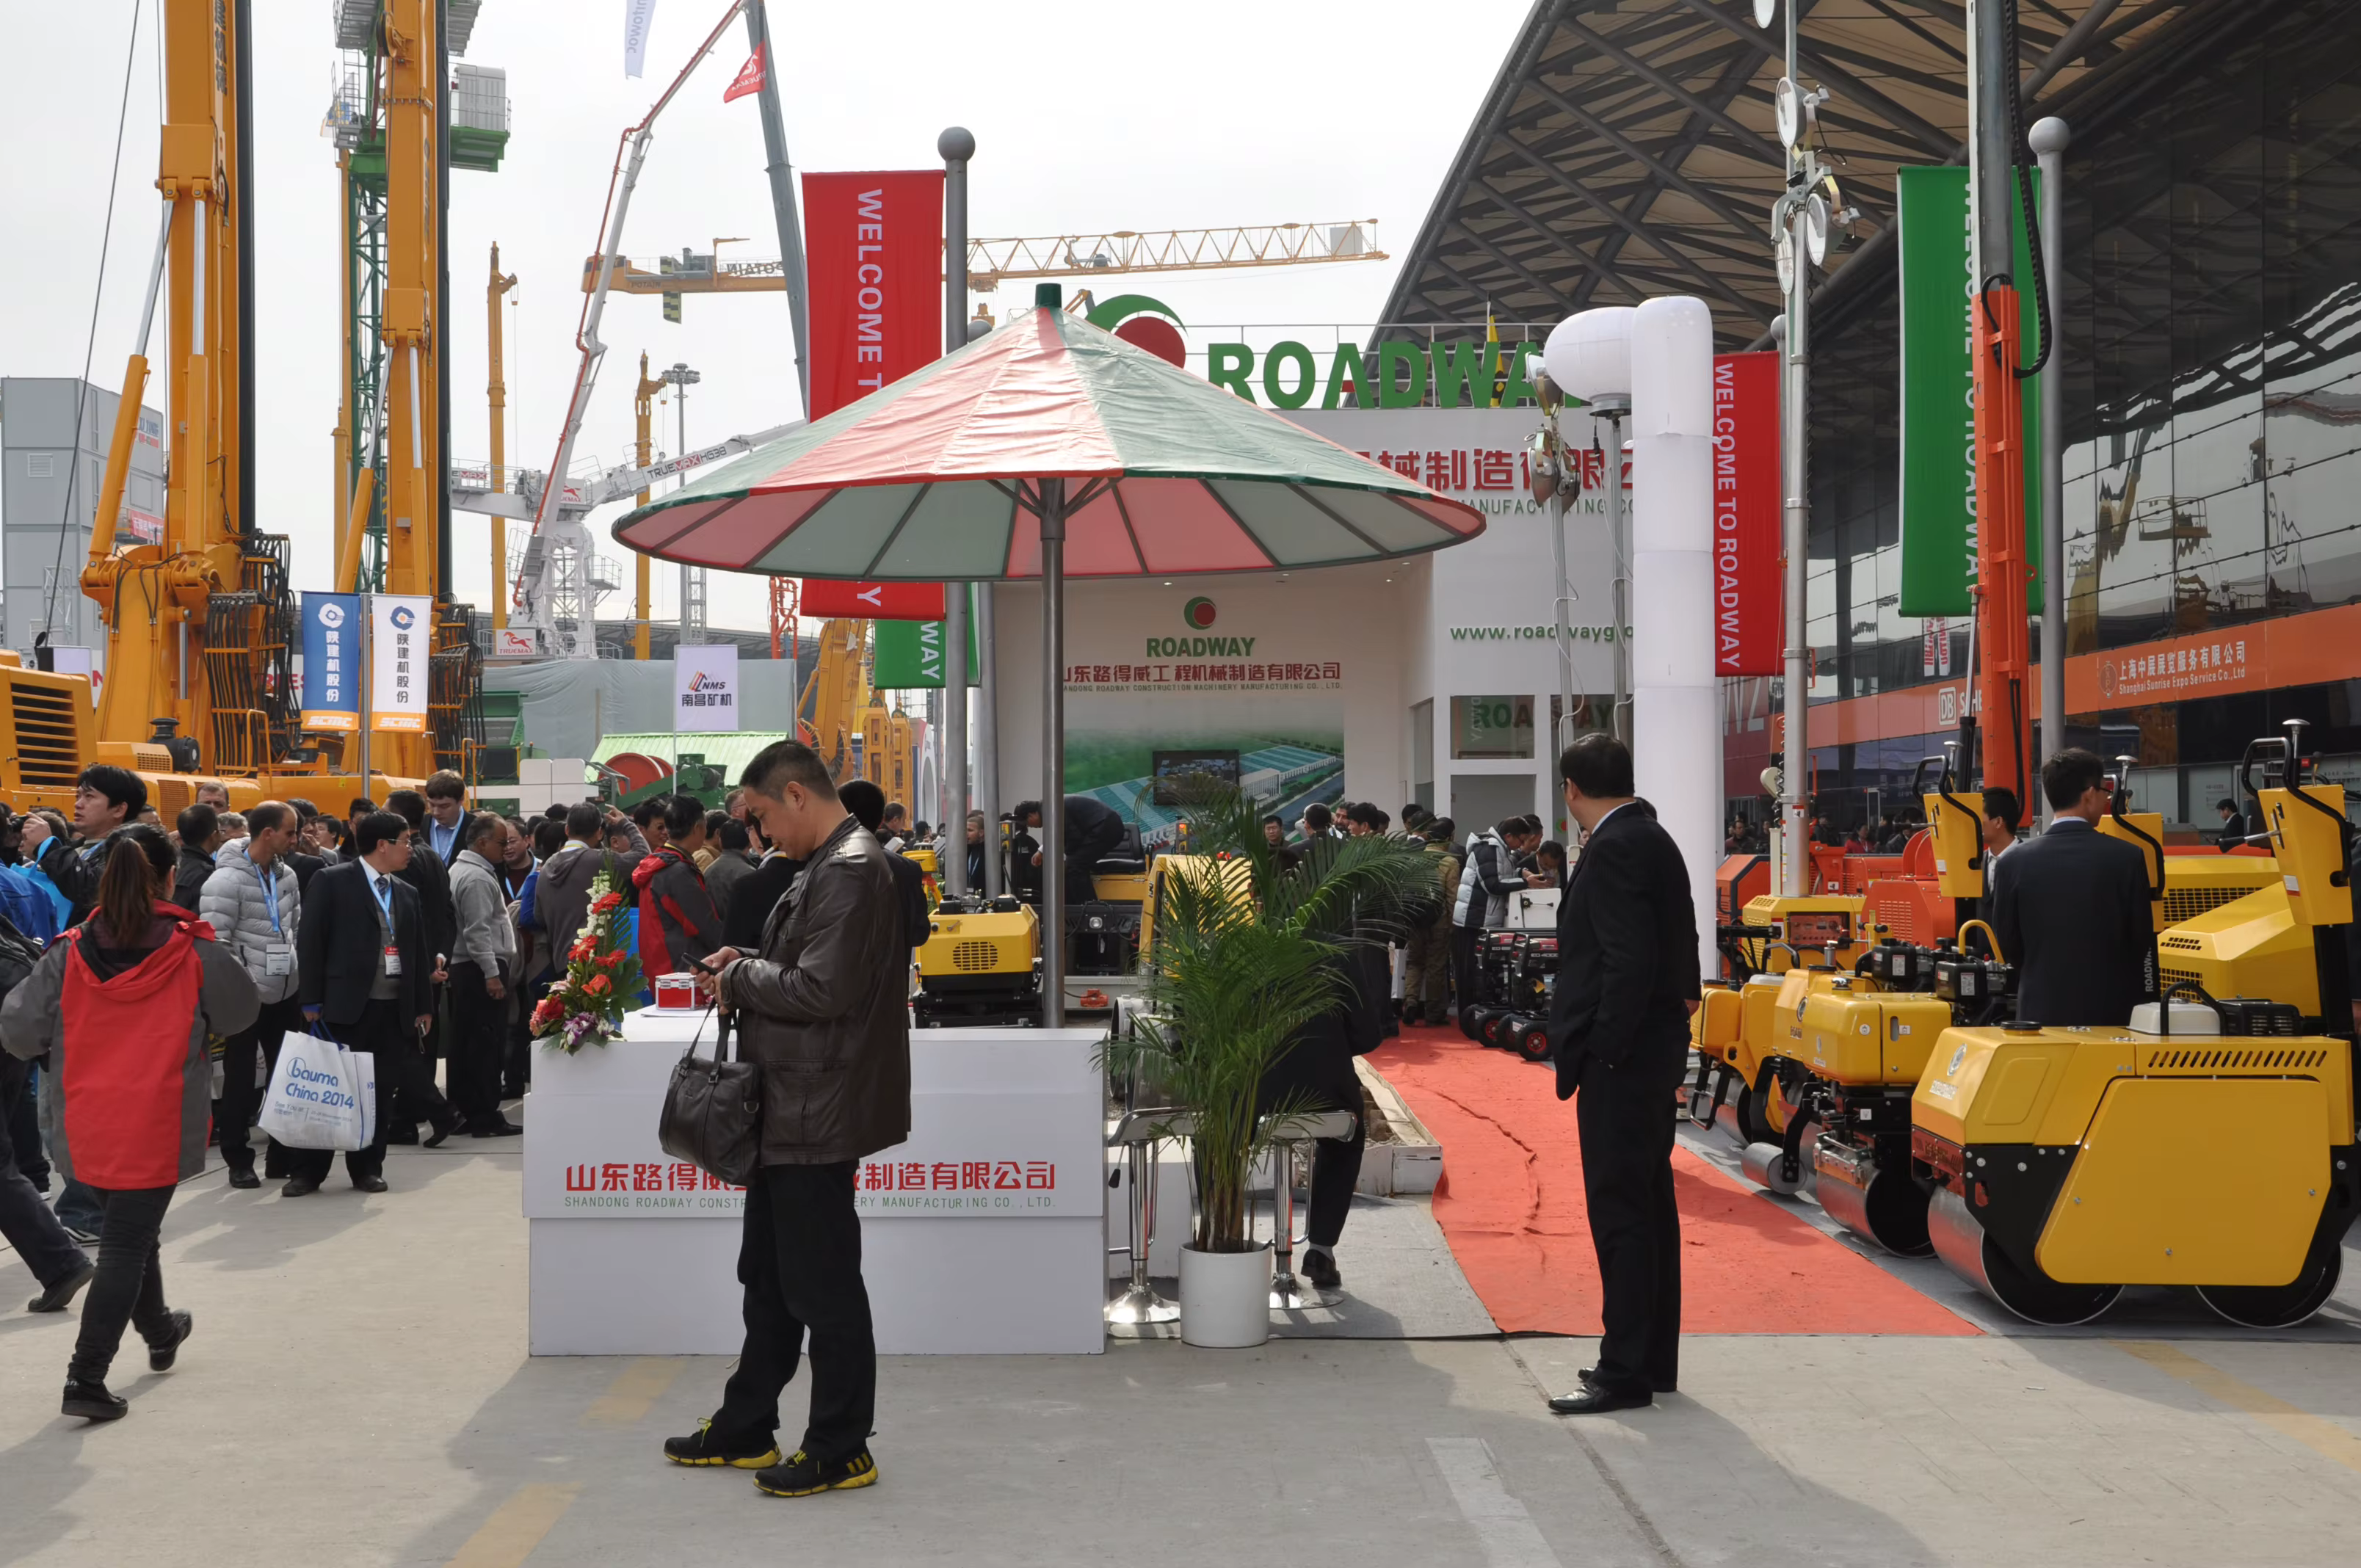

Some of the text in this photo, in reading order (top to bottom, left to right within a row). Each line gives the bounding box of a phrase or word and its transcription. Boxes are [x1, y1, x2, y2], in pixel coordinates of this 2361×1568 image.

[857, 189, 882, 362] WELCOME
[1208, 341, 1582, 410] ROADWA
[1715, 363, 1740, 668] WELCOME TO ROADWAY
[1146, 637, 1255, 657] ROADWAY
[326, 631, 340, 702] 陕建机股份
[396, 634, 410, 703] 陕建机股份
[1063, 684, 1093, 692] ANDONG
[1096, 684, 1130, 692] ROADWAY
[1133, 683, 1191, 692] CONSTRUCTION
[2119, 682, 2147, 695] Shanghai
[2147, 679, 2171, 691] Sunrise
[2172, 676, 2188, 689] Expo
[2190, 673, 2216, 686] Service
[681, 693, 732, 707] 南昌矿机
[1940, 689, 1982, 719] DB SHE
[2144, 947, 2154, 992] ROADWA
[291, 1059, 338, 1087] bauma
[286, 1082, 319, 1102] China
[321, 1090, 355, 1109] 2014
[565, 1197, 629, 1208] SHANDONG
[636, 1197, 692, 1208] ROADWAY
[882, 1197, 988, 1209] MANUFACTURING
